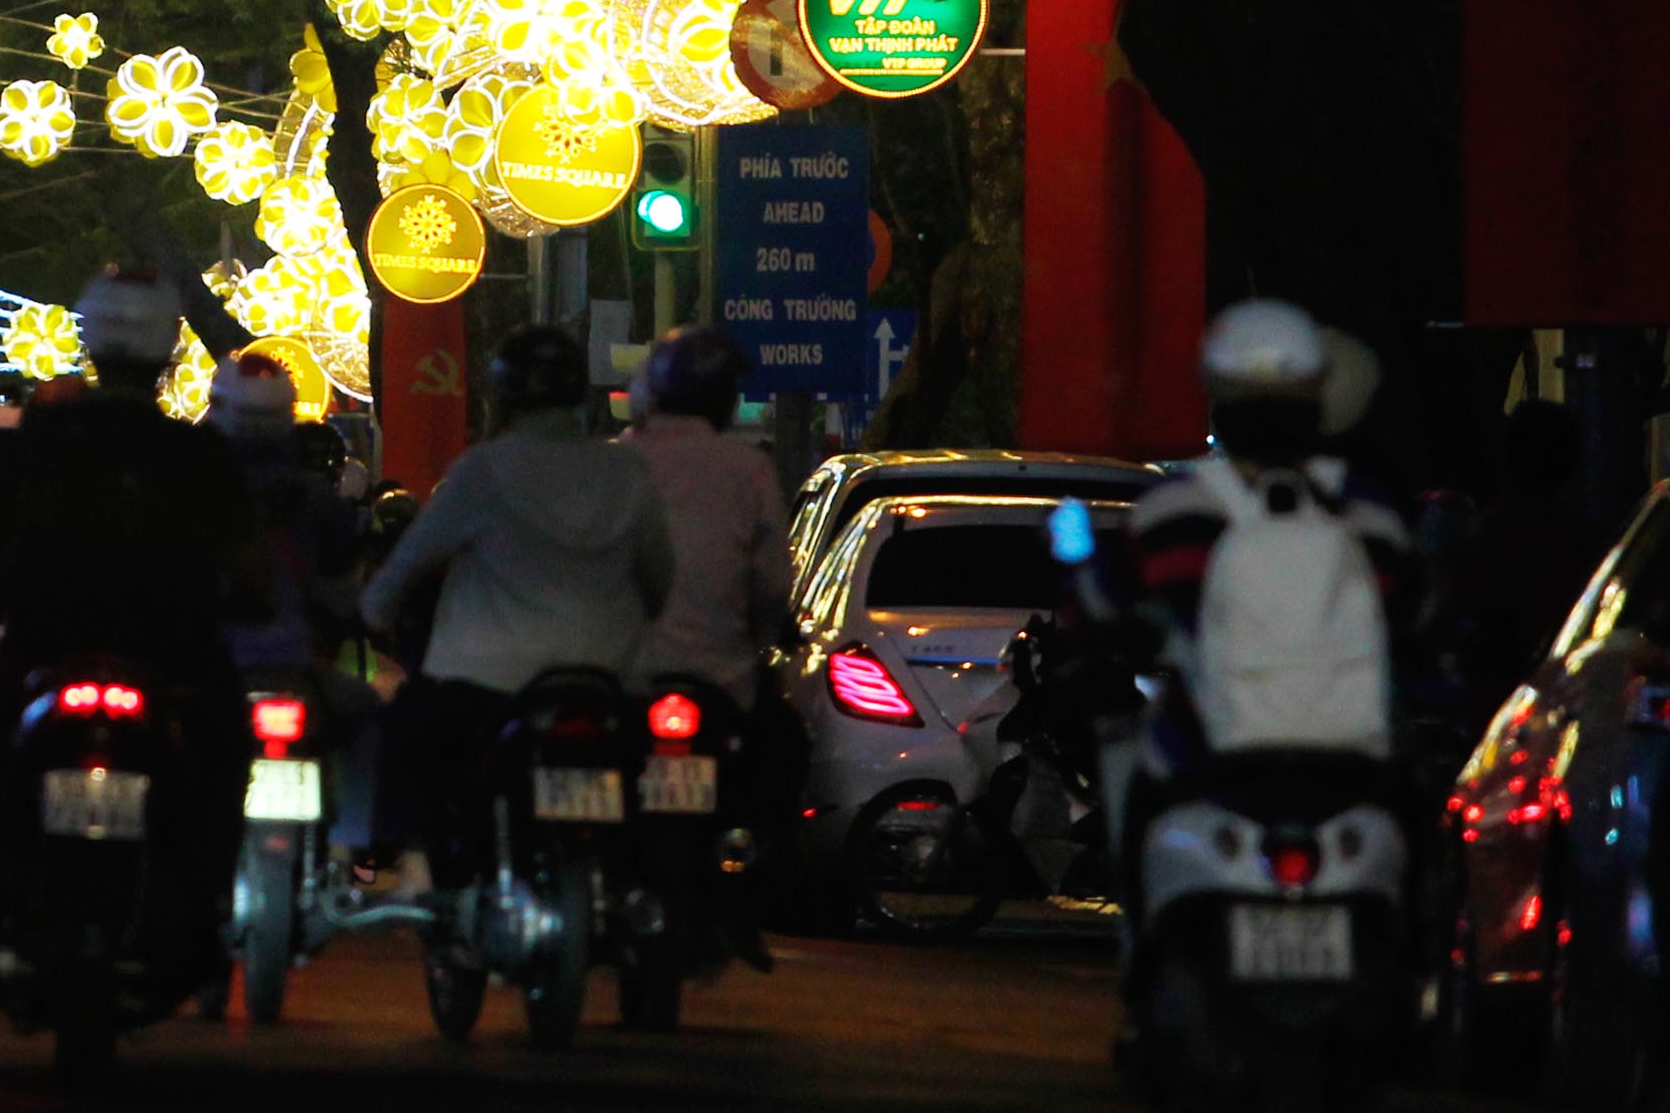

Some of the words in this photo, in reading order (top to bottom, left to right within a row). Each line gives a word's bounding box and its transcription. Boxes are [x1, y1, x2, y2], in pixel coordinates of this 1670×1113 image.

[501, 161, 553, 183] TIMES
[554, 167, 629, 190] SQUARE
[763, 201, 825, 224] AHEAD
[374, 253, 419, 271] TIMES
[420, 256, 477, 275] SQUARE
[756, 247, 791, 272] 260
[794, 252, 815, 272] m
[724, 293, 774, 321] CÔNG
[760, 344, 824, 365] WORKS
